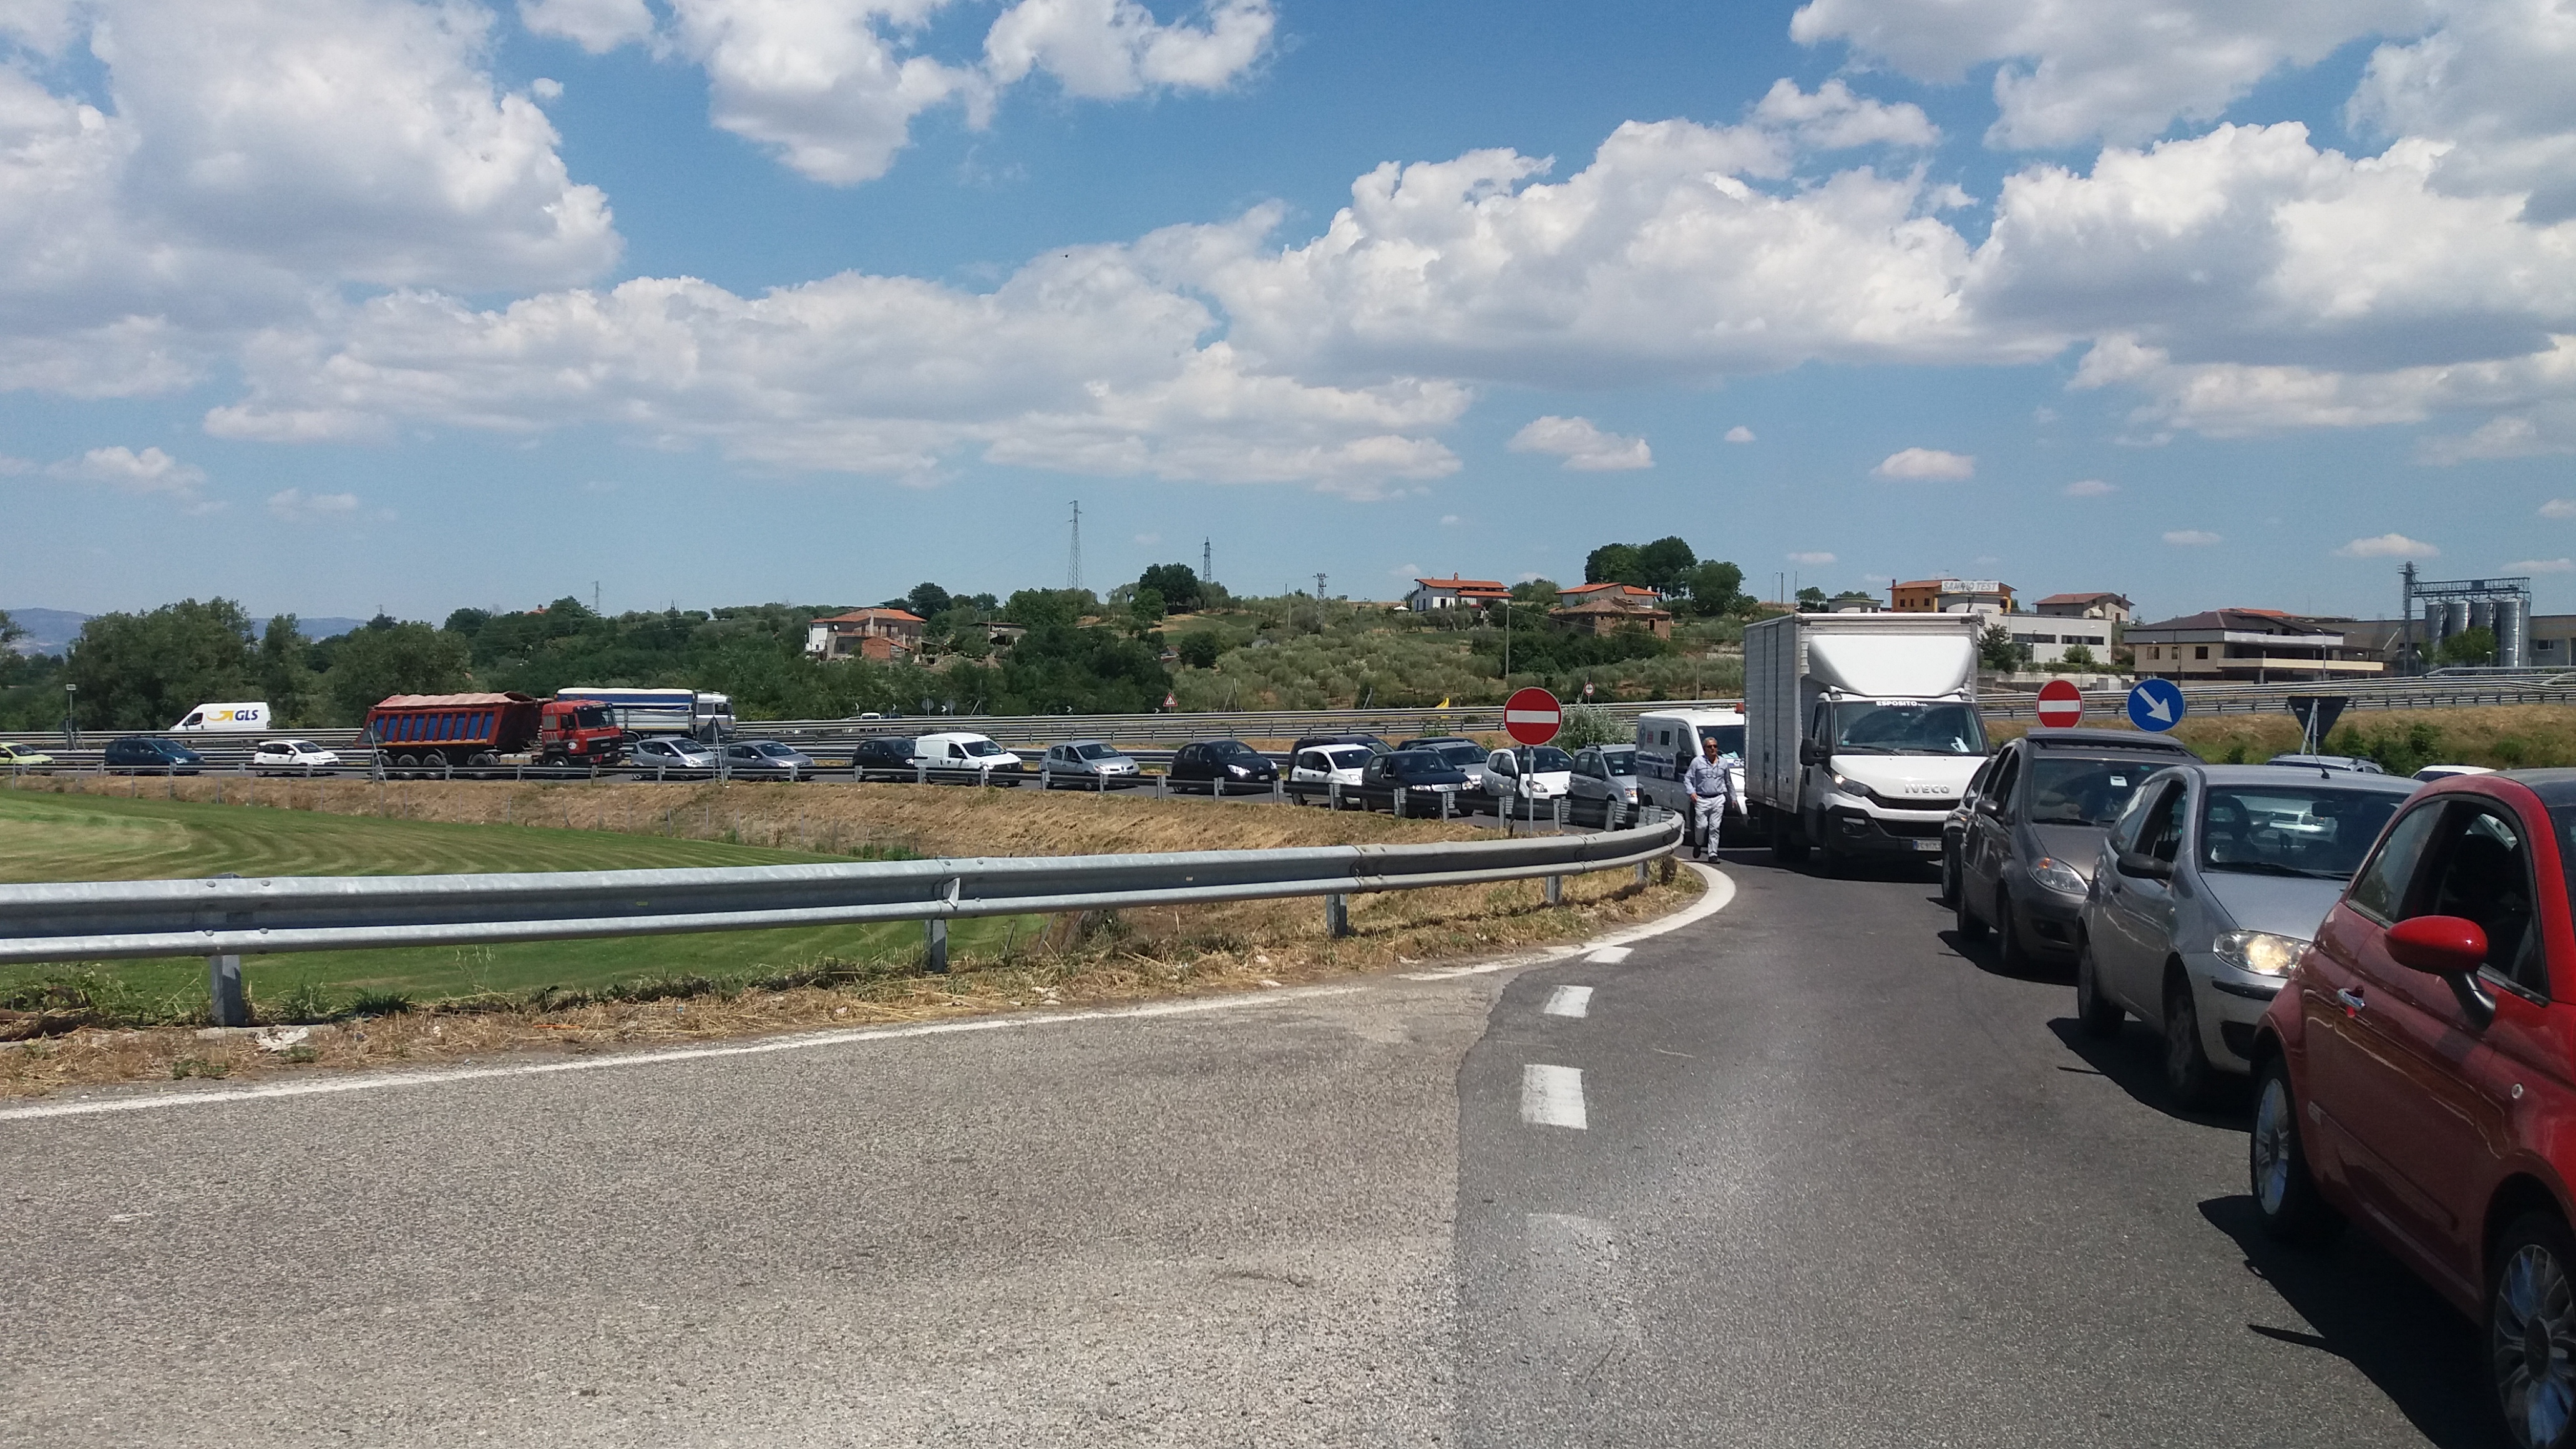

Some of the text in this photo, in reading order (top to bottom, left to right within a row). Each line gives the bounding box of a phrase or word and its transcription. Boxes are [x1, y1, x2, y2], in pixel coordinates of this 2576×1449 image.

[1976, 582, 1997, 590] TEST
[235, 710, 258, 721] GLS
[1905, 784, 1950, 794] IVECO
